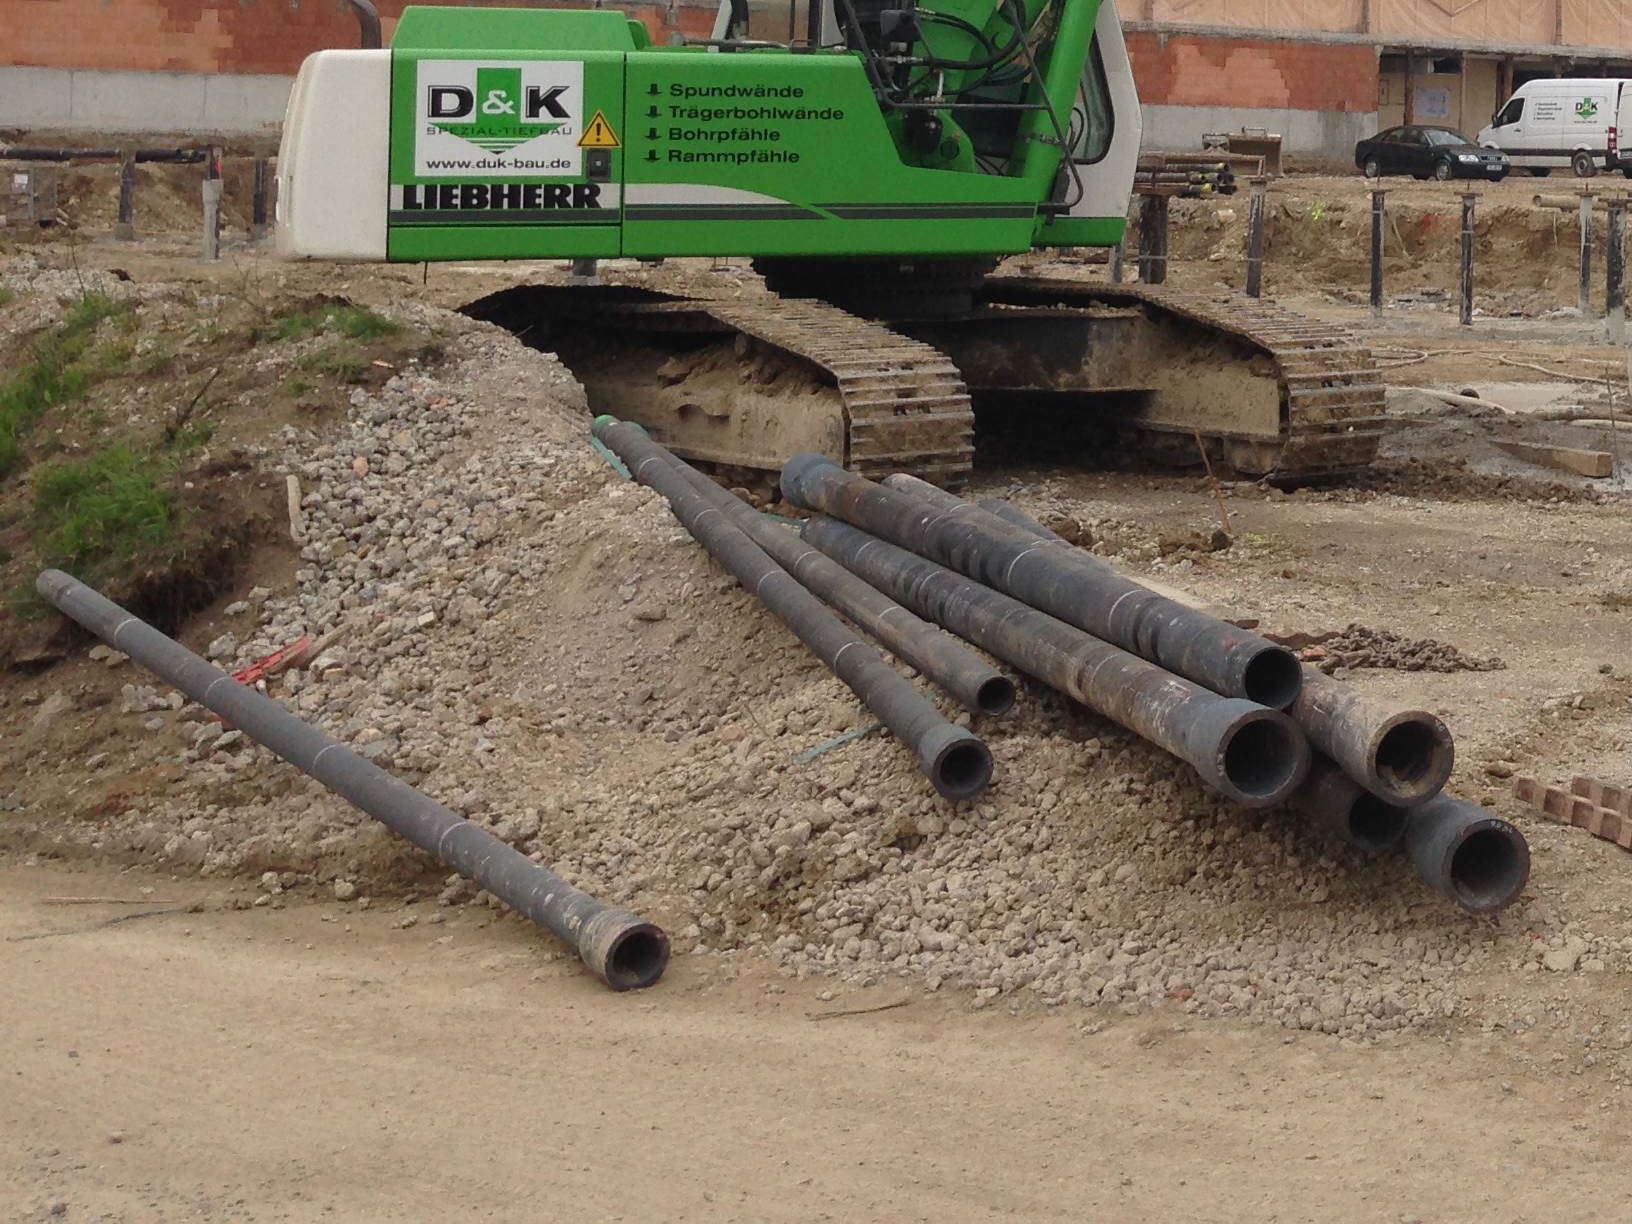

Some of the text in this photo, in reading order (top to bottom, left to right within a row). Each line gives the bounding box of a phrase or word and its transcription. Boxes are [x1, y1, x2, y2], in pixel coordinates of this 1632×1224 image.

[670, 84, 804, 99] Spundwände
[427, 85, 571, 119] D&K
[668, 105, 844, 121] Trägerbohlwände
[669, 128, 781, 143] Bohrpfähle
[427, 158, 571, 169] www.duk-bau.de
[668, 149, 800, 165] Rammpfähle
[403, 184, 601, 210] LIEBHERR
